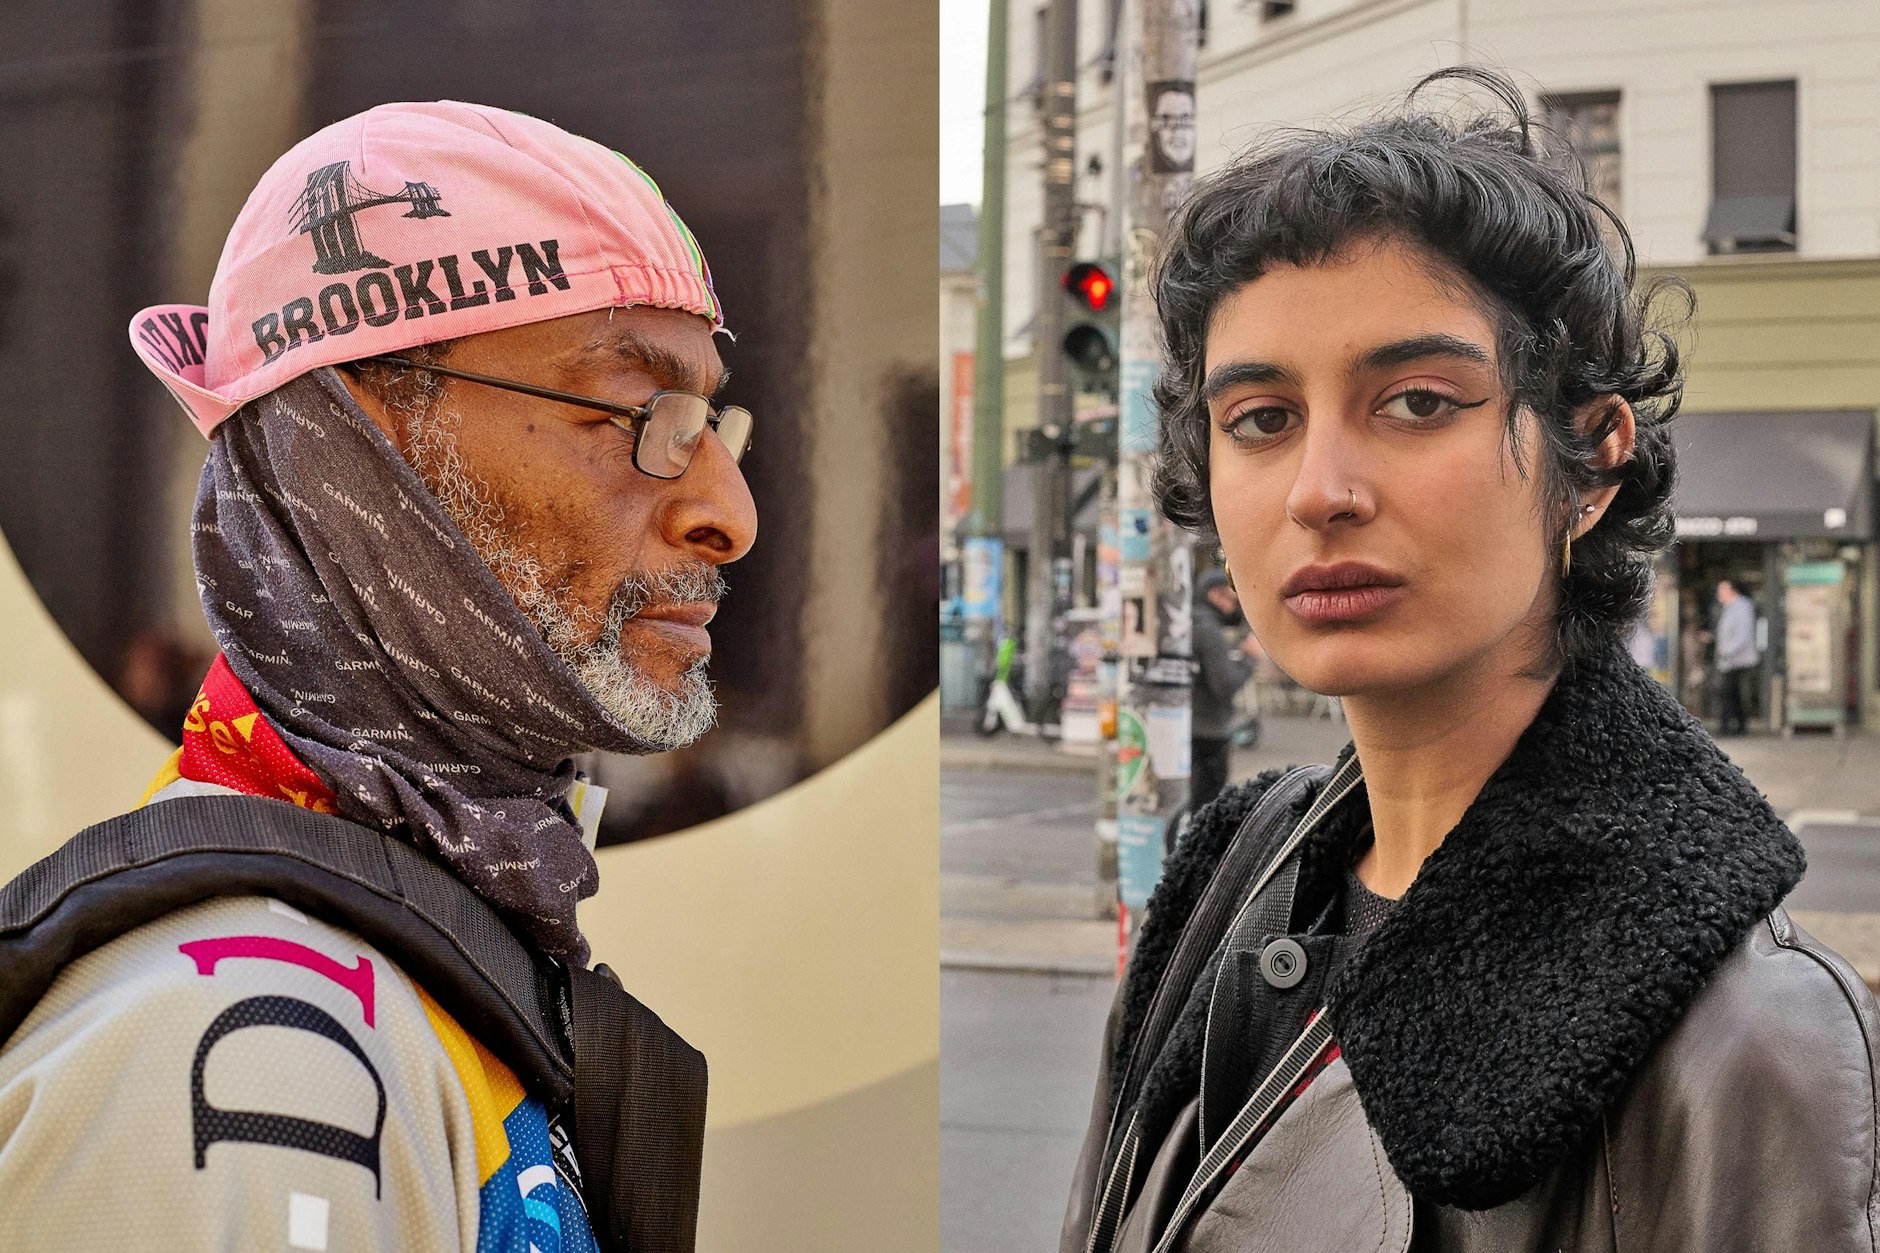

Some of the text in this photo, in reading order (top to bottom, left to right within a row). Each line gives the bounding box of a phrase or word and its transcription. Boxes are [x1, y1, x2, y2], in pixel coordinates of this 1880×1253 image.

[252, 239, 571, 367] BROOKLYN
[323, 482, 385, 535] GARMIN
[225, 600, 253, 619] GAR
[386, 568, 446, 624] GARMIN
[464, 598, 525, 655] GARMIN
[247, 648, 290, 665] ARMIN
[352, 727, 409, 741] GARMIN
[454, 711, 491, 726] GARM
